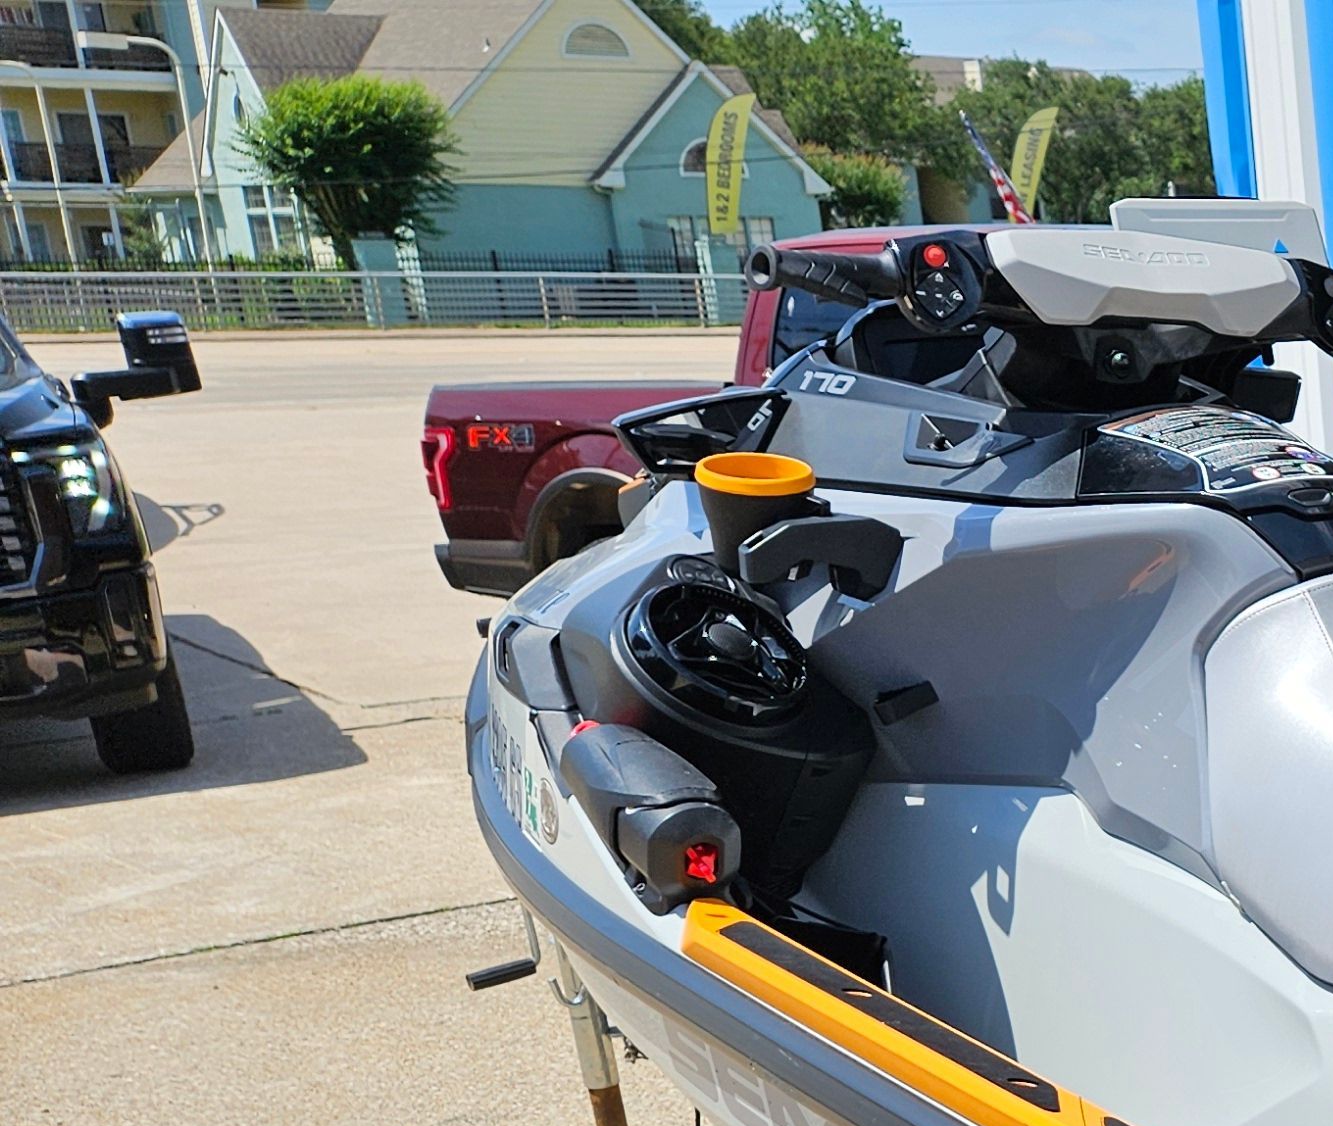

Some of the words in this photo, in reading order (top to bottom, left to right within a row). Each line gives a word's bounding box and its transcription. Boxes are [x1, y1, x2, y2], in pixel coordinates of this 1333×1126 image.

[716, 111, 738, 189] BEDROOMS
[799, 370, 857, 395] 170
[467, 423, 534, 452] FX4
